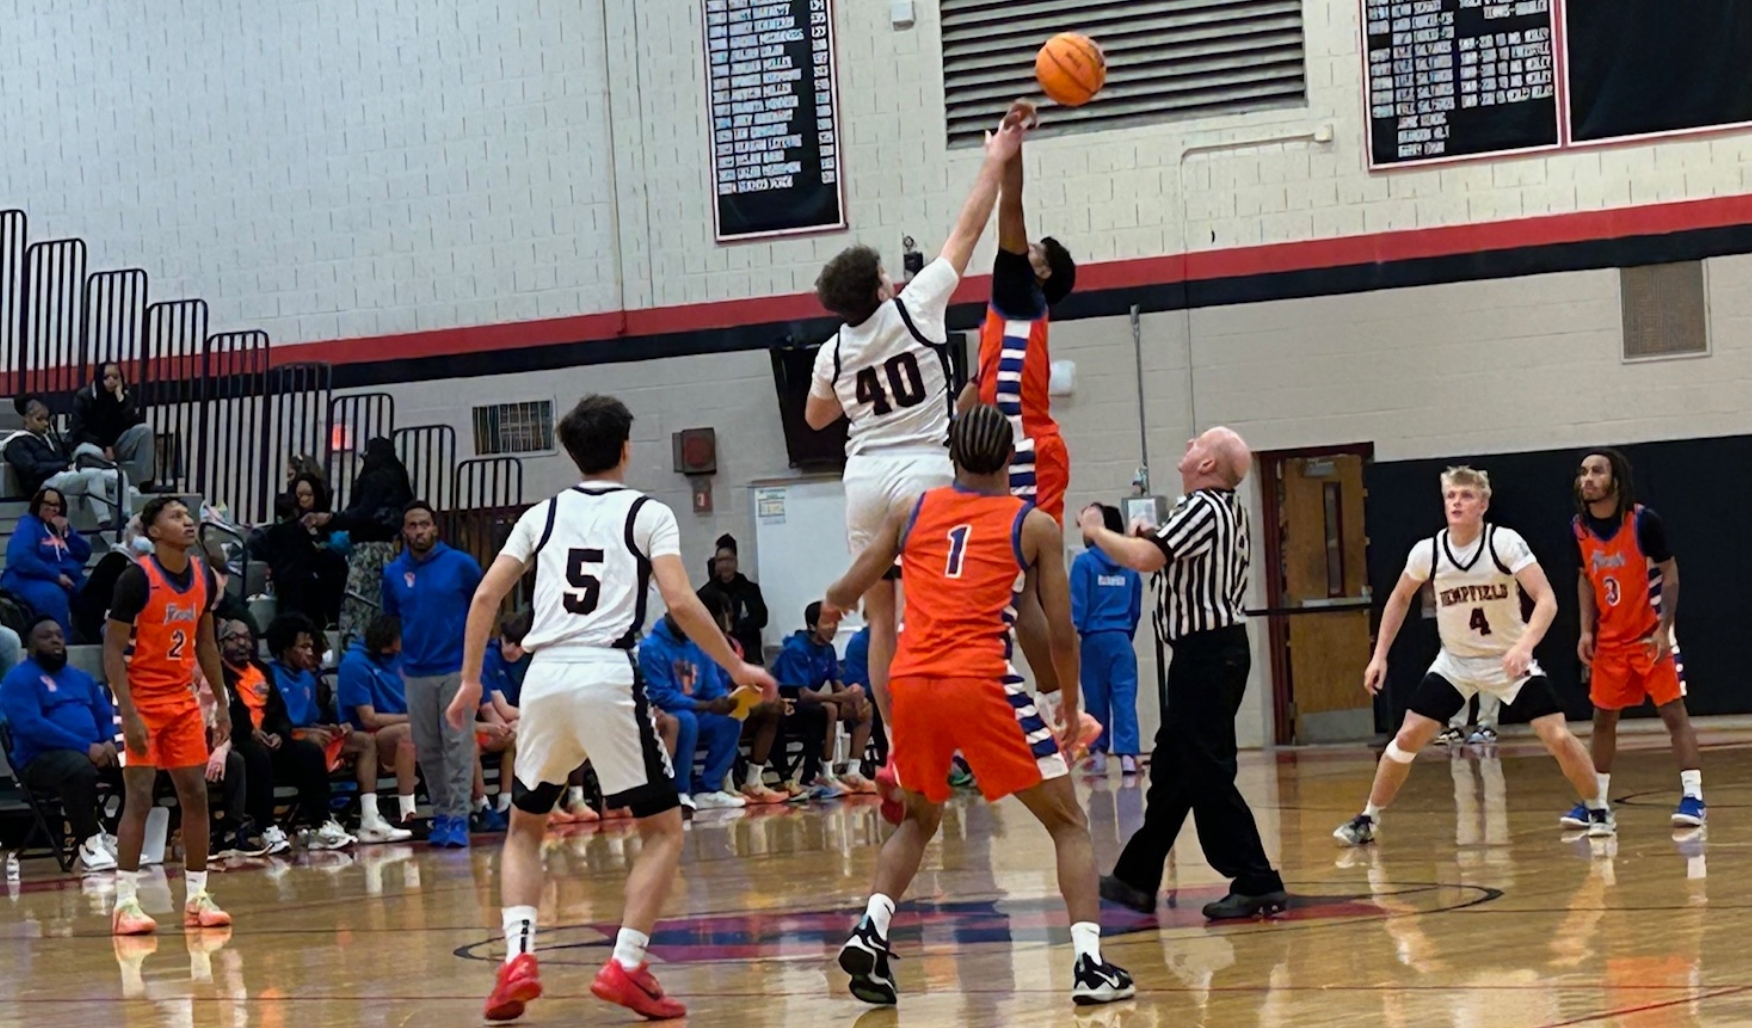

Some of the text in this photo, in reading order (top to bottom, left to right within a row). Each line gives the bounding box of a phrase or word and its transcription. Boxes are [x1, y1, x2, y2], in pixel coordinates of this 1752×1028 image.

[856, 352, 926, 416] 40
[946, 524, 972, 578] 1
[563, 548, 604, 615] 5
[1603, 575, 1621, 607] 3
[1469, 608, 1492, 636] 4
[166, 629, 187, 661] 2
